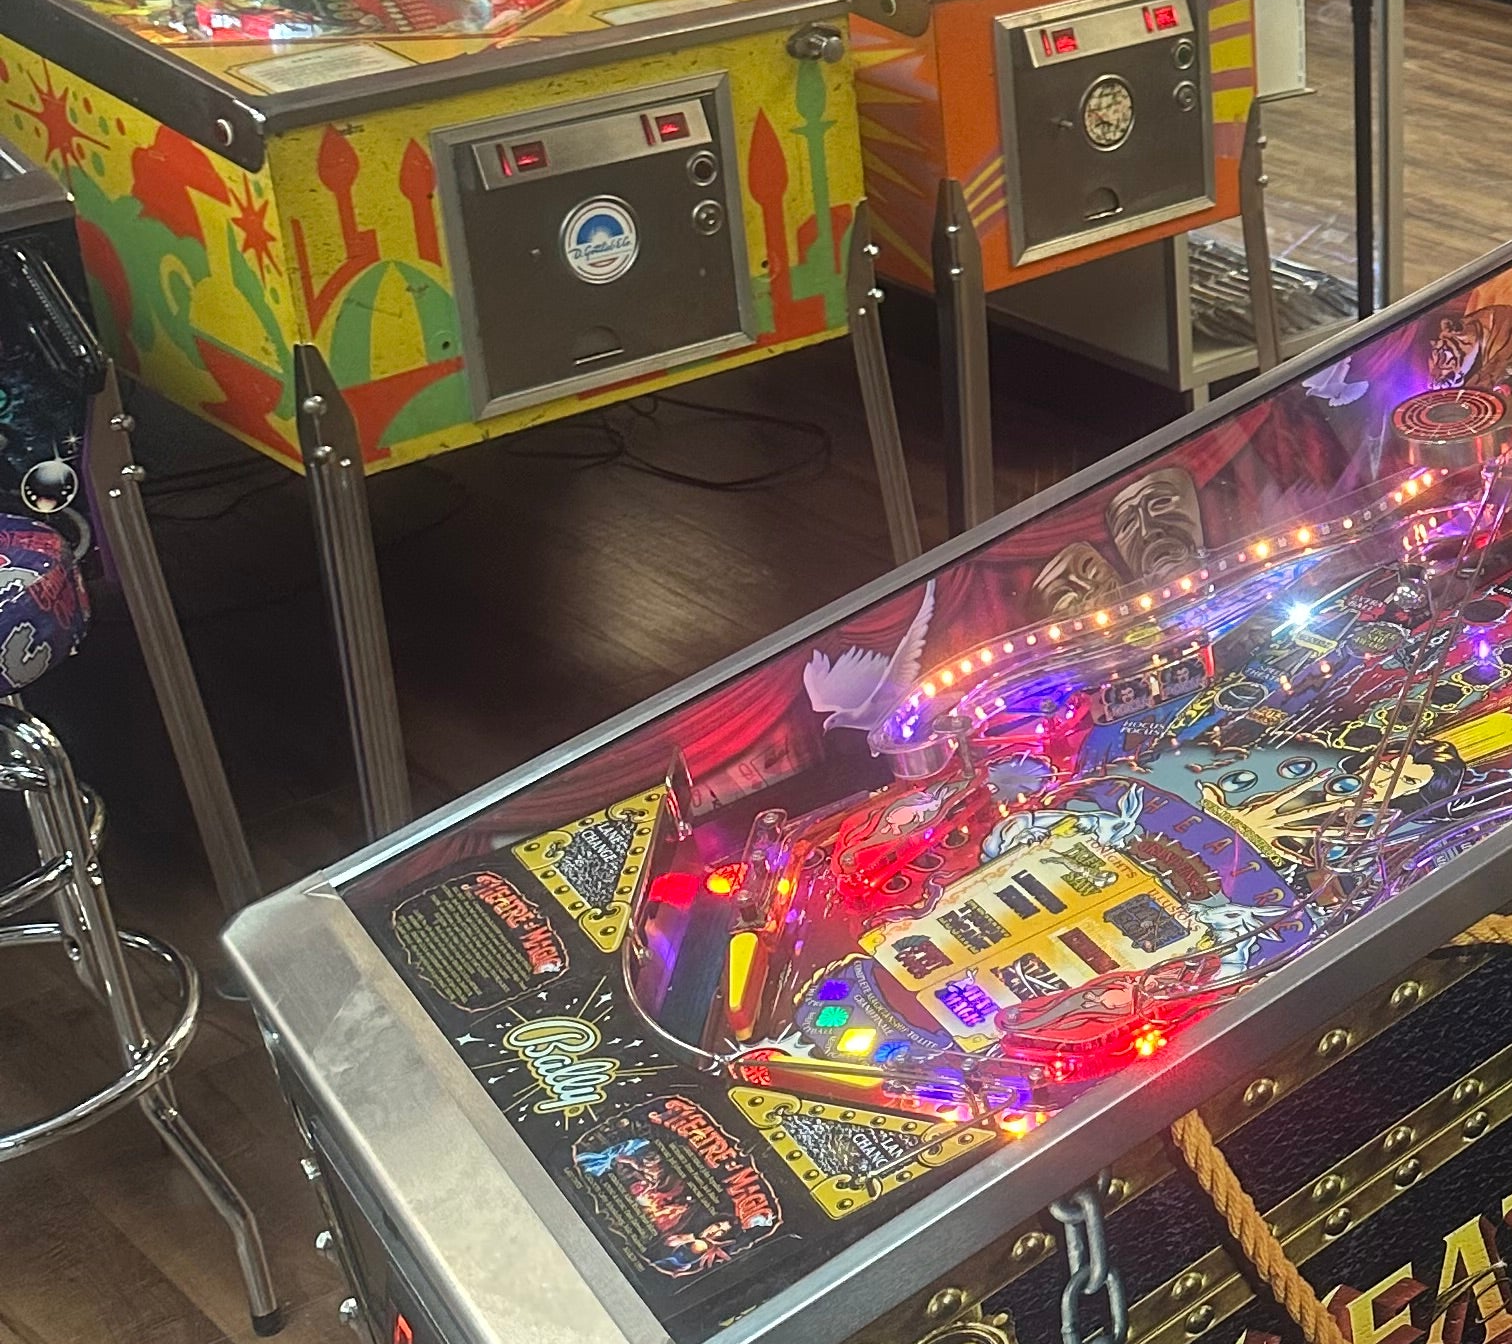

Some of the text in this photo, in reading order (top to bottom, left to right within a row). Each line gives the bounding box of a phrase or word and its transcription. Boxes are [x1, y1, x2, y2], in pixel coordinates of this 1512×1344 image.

[1120, 726, 1163, 736] POCUS
[1123, 720, 1165, 730] HOCUS
[582, 830, 617, 862] CHANGE
[597, 822, 625, 844] LANE
[1085, 838, 1137, 879] TONIGHTS
[461, 875, 536, 929] THEATRE
[1149, 889, 1201, 933] ILLUSIONS
[502, 1016, 623, 1116] Bally
[649, 1099, 774, 1230] THEATRE MAGIC
[881, 1138, 904, 1158] LAN
